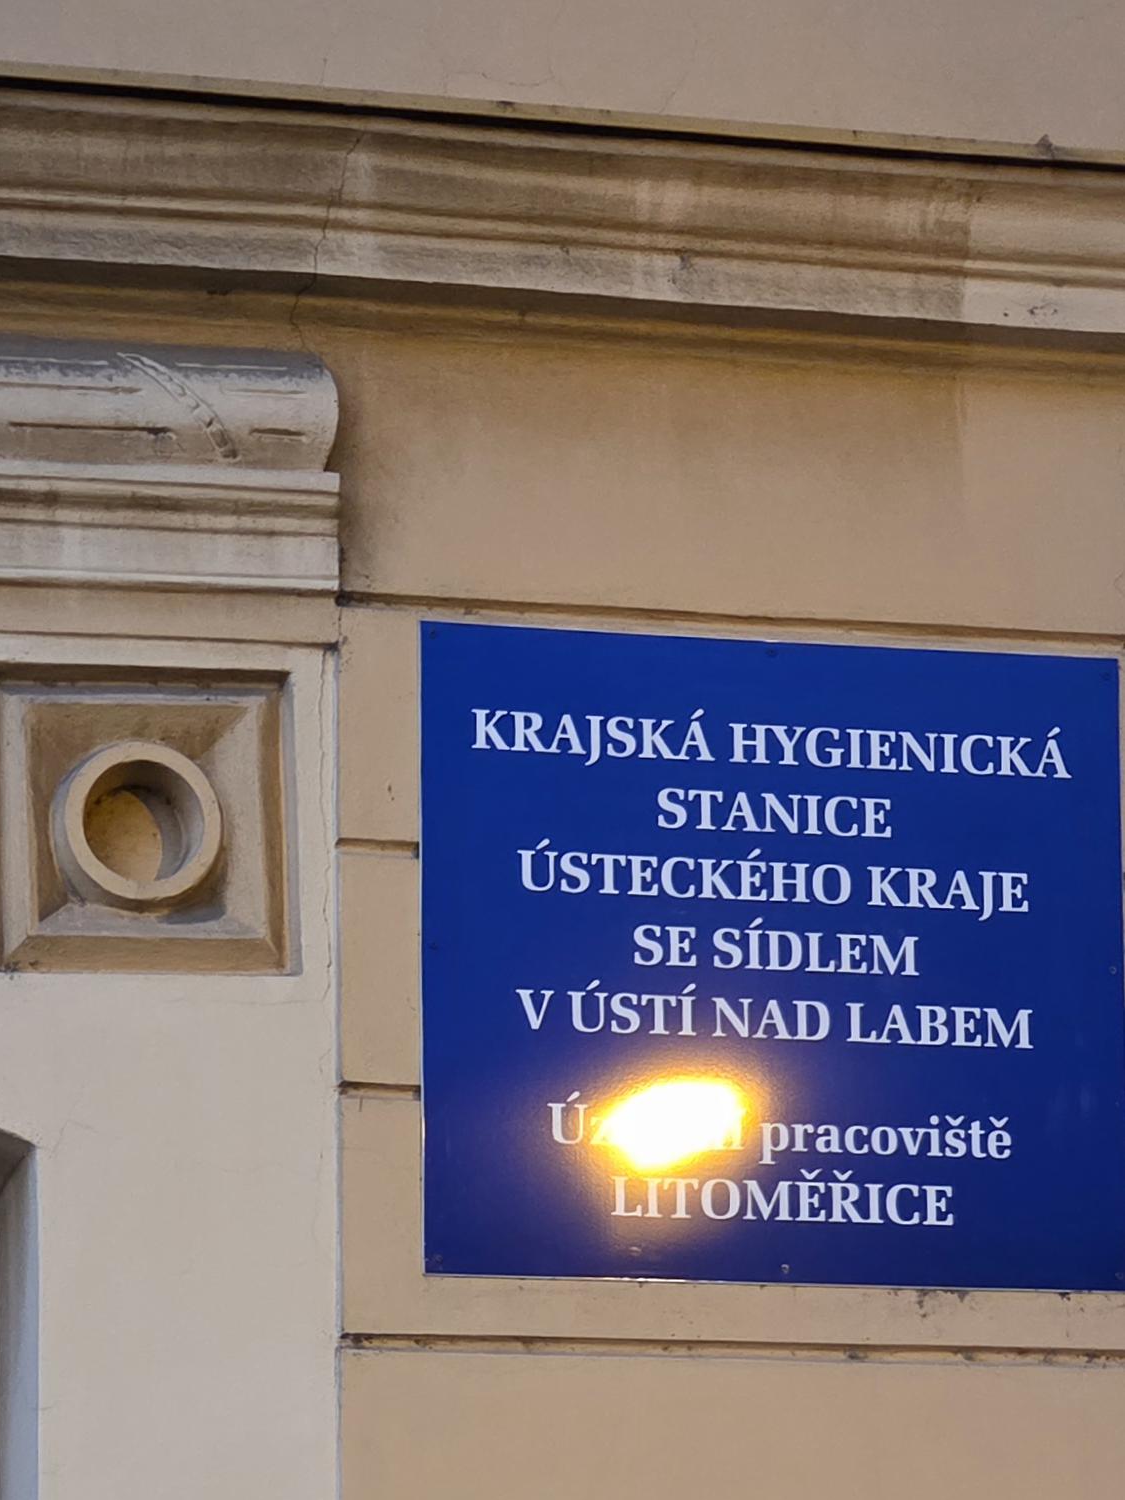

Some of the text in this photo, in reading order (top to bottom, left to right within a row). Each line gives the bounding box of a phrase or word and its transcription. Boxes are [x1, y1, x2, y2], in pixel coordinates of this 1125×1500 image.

[472, 709, 1071, 778] KRAJSKÁ HYGIENICKÁ
[657, 788, 892, 838] STANICE
[517, 839, 1029, 921] ÚSTECKÉHO KRAJE
[633, 918, 920, 976] SE SÍDLEM
[516, 980, 1034, 1049] V ÚSTÍ NAD LABEM
[759, 1115, 1012, 1164] pracoviště
[611, 1170, 954, 1226] LITOMĚŘICE
